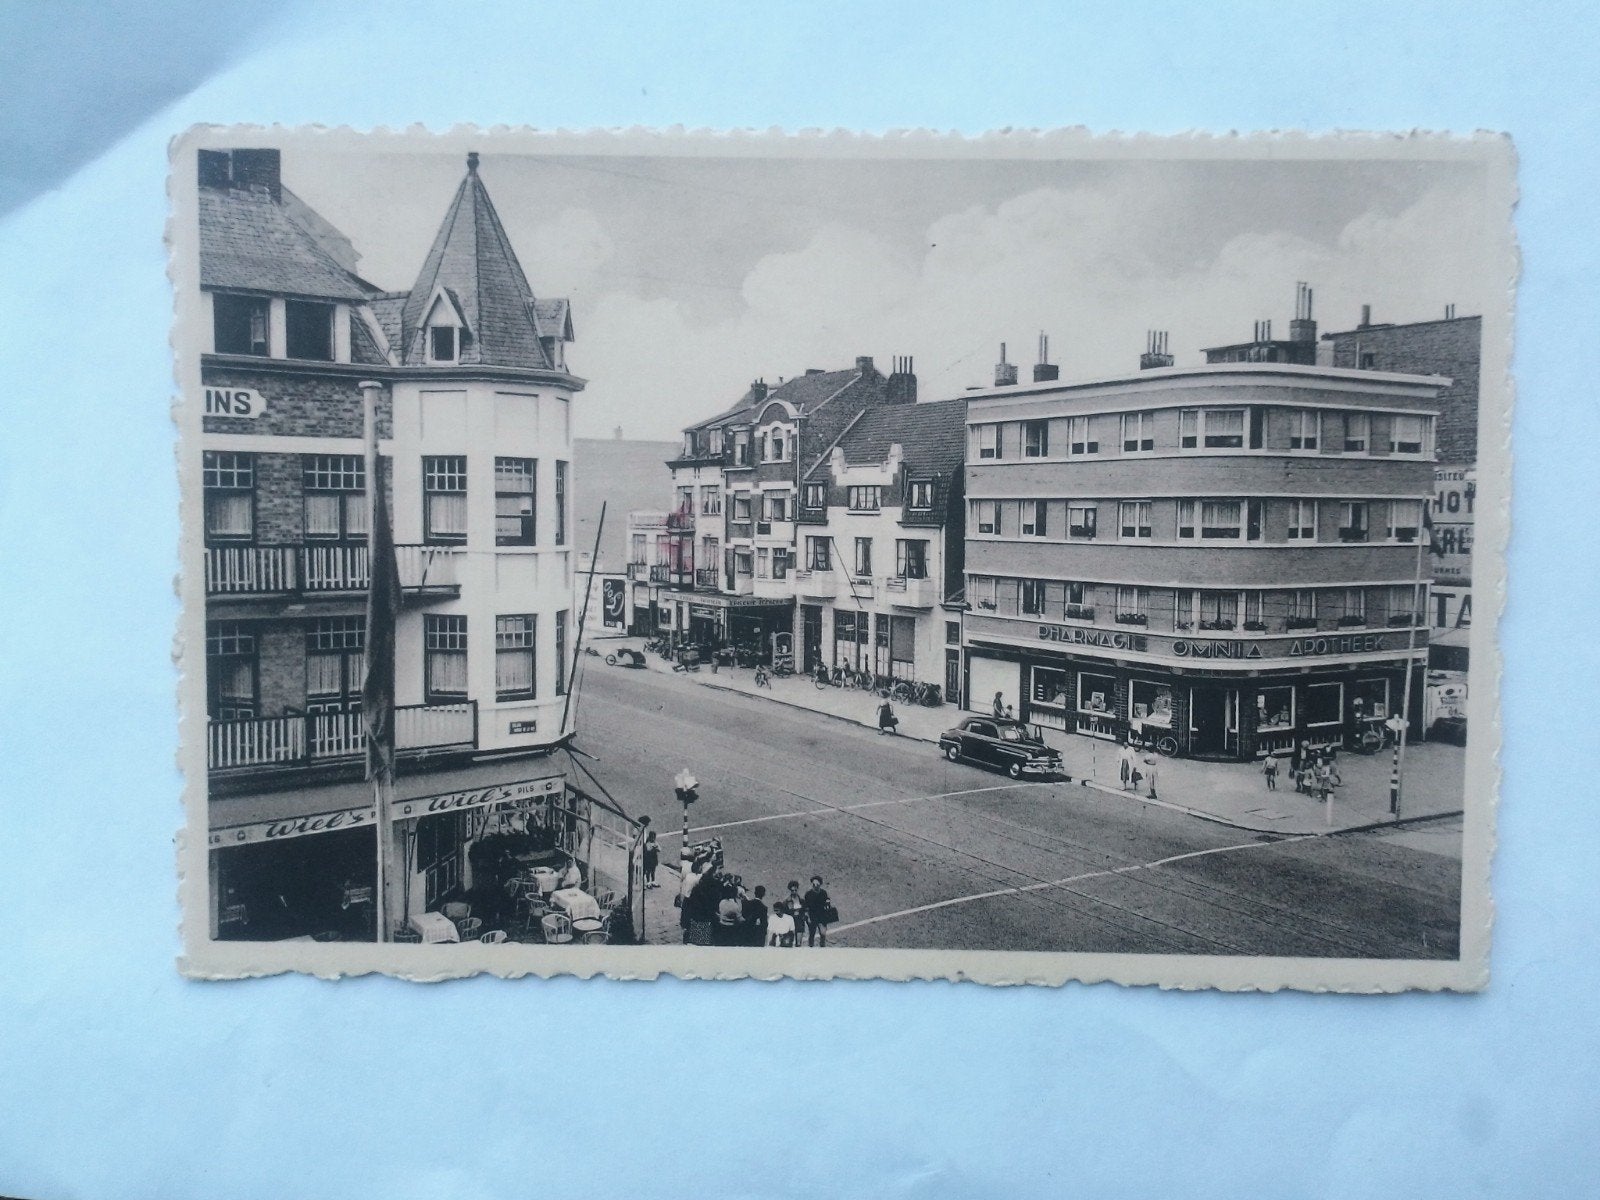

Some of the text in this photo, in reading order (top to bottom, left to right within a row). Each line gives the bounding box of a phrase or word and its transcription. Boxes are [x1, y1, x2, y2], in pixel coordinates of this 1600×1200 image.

[206, 389, 251, 414] INS
[1037, 625, 1385, 659] PHARMACIE OMNIA APOTHEEK
[517, 784, 535, 795] PILS
